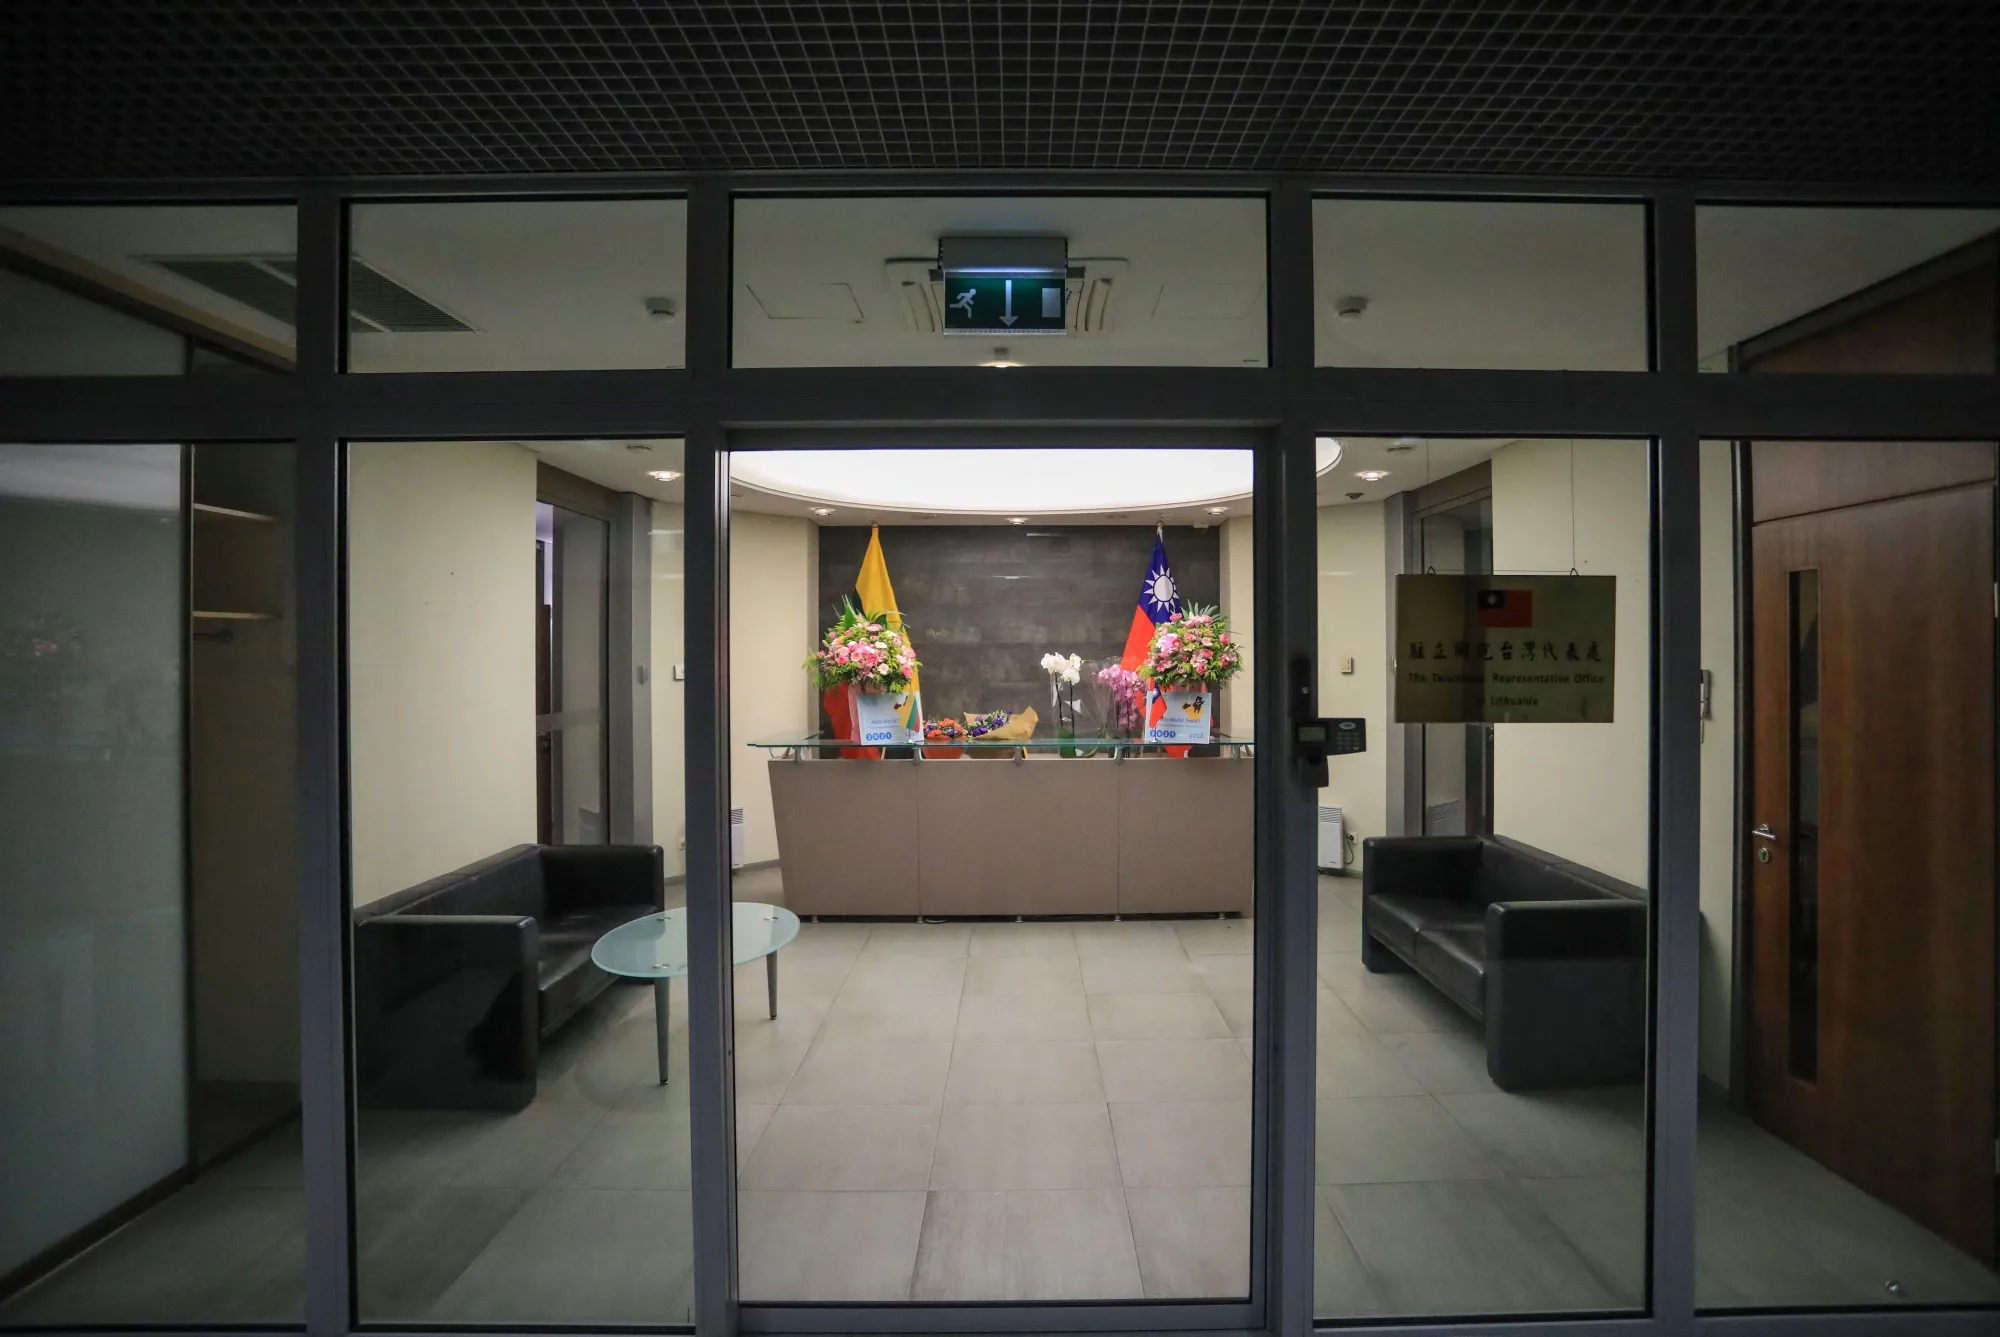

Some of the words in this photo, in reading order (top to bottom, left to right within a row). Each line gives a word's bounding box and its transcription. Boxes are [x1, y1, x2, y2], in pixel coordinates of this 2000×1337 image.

[1408, 673, 1427, 683] The
[1432, 673, 1484, 683] Taiwa
[1493, 673, 1569, 684] Representative
[1574, 673, 1604, 683] Office
[1491, 696, 1538, 706] Lithuania
[866, 732, 892, 741] 2021
